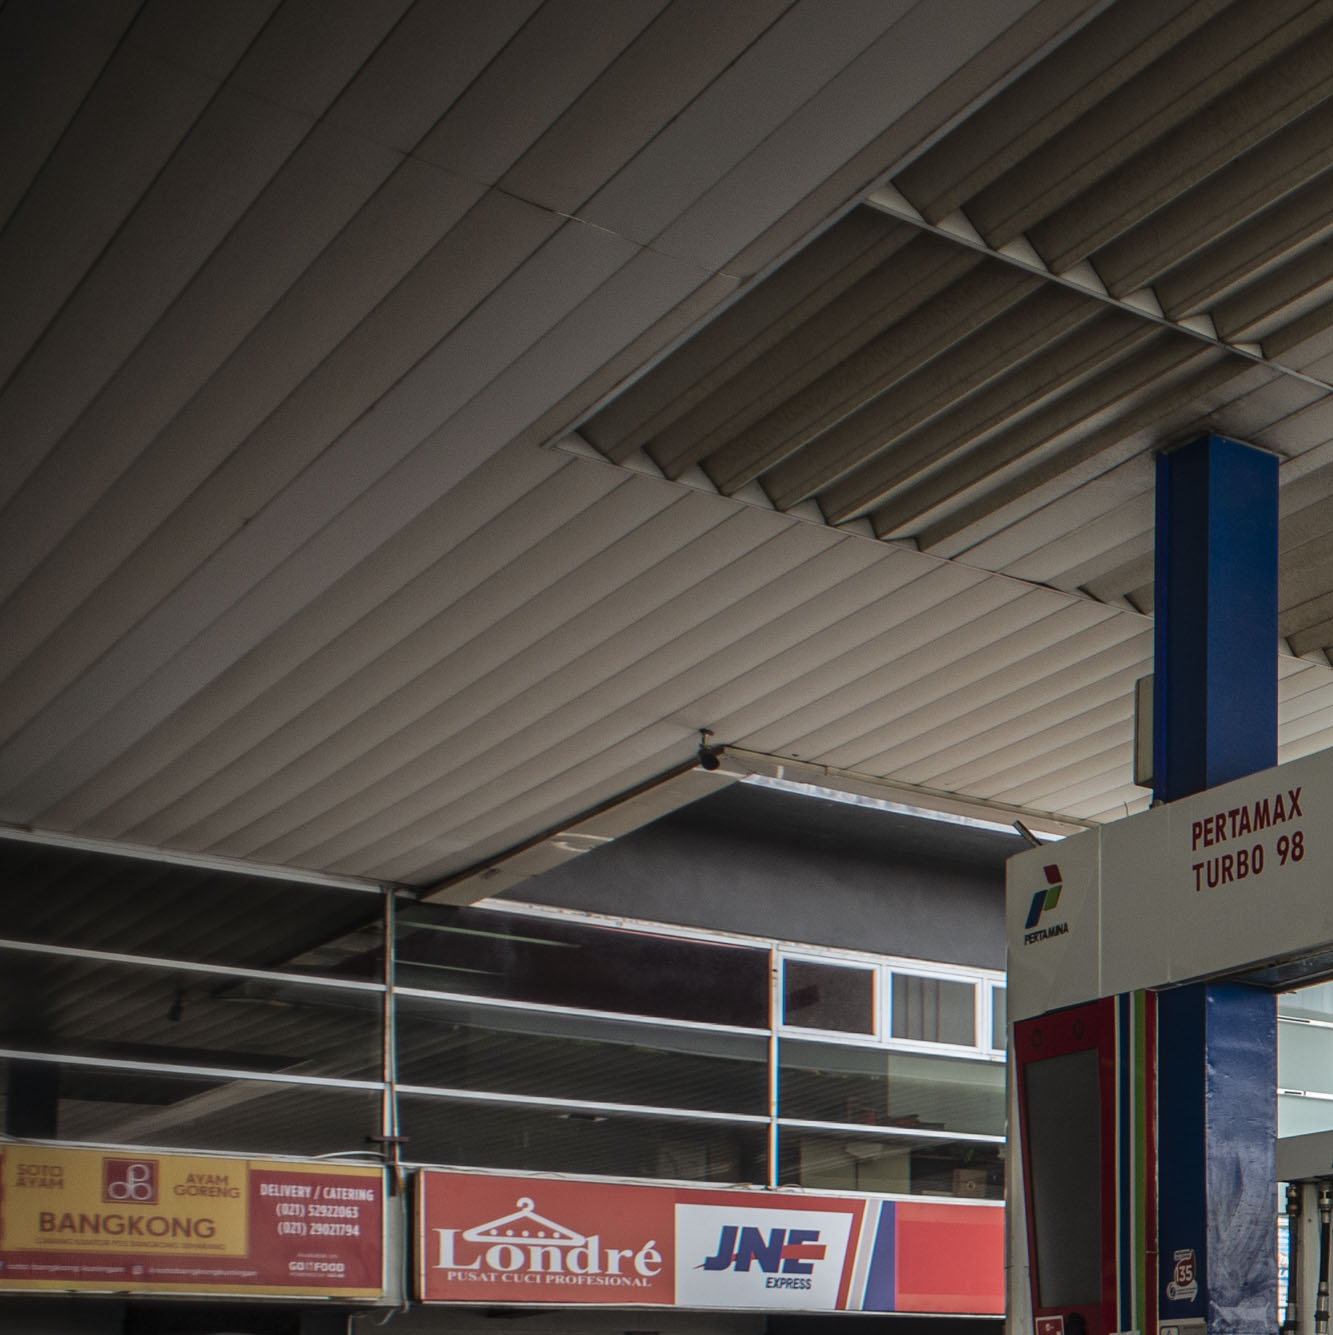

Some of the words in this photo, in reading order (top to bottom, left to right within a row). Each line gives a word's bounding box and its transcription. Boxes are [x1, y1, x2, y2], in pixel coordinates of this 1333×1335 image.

[1192, 787, 1303, 851] PERTAMAX
[1192, 845, 1264, 892] TURBO
[1276, 830, 1305, 866] 98
[1023, 922, 1069, 946] PERTAMINA
[16, 1164, 64, 1177] SOTO
[15, 1177, 64, 1189] AYAM
[185, 1173, 229, 1186] AYAM
[173, 1184, 241, 1199] GORENG
[260, 1184, 312, 1198] DELIVERY
[313, 1186, 320, 1199] /
[323, 1187, 375, 1201] CATERING
[276, 1203, 305, 1217] (021)
[308, 1204, 359, 1218] 52922063
[39, 1211, 216, 1239] BANGKONG
[277, 1222, 307, 1235] (021)
[310, 1223, 360, 1236] 29021794
[432, 1226, 663, 1277] Londré
[699, 1224, 826, 1275] JNE
[447, 1270, 499, 1283] PUSAT
[502, 1271, 542, 1284] CUCI
[545, 1273, 653, 1288] PROFESIONAL
[1176, 1264, 1193, 1282] 135
[765, 1276, 812, 1290] EXPRESS
